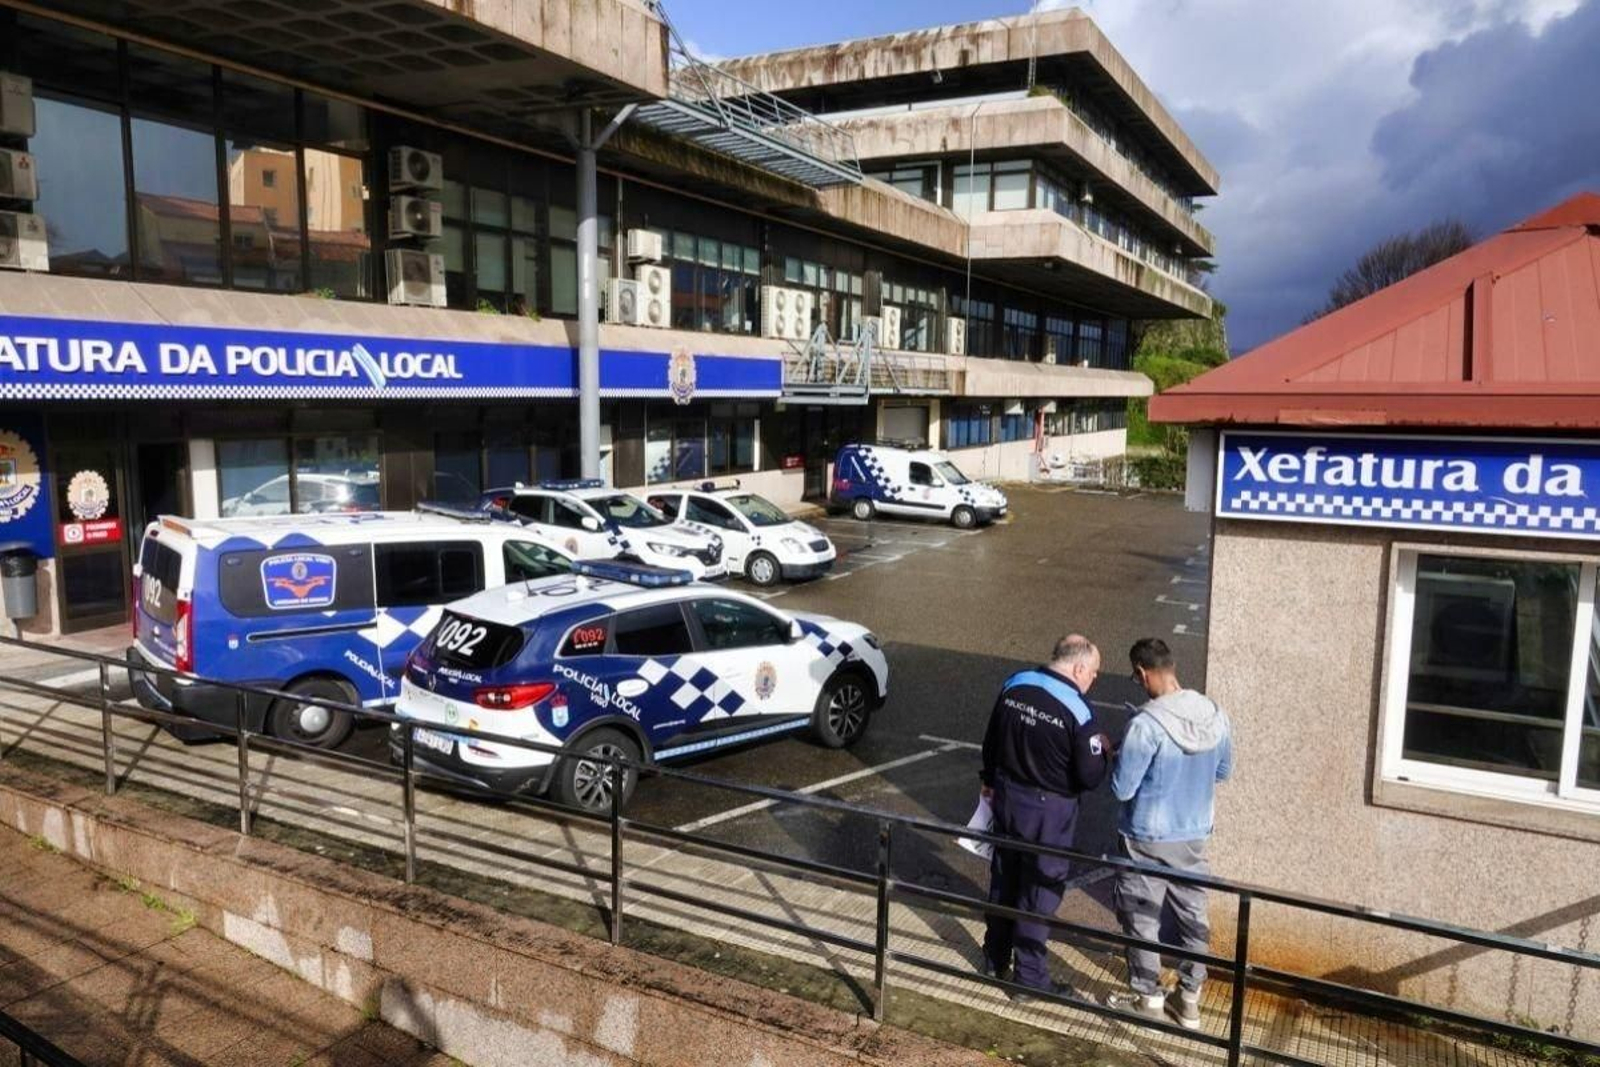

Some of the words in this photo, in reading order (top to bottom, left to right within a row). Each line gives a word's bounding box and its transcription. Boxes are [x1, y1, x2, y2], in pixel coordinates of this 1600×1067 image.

[159, 342, 217, 376] DA
[226, 344, 358, 379] POLICIA
[380, 351, 463, 379] LOCAL
[1233, 446, 1479, 491] Xefatura
[1503, 454, 1588, 498] da
[436, 619, 487, 656] 092
[590, 691, 609, 709] VIGO
[611, 690, 641, 722] LOCAL
